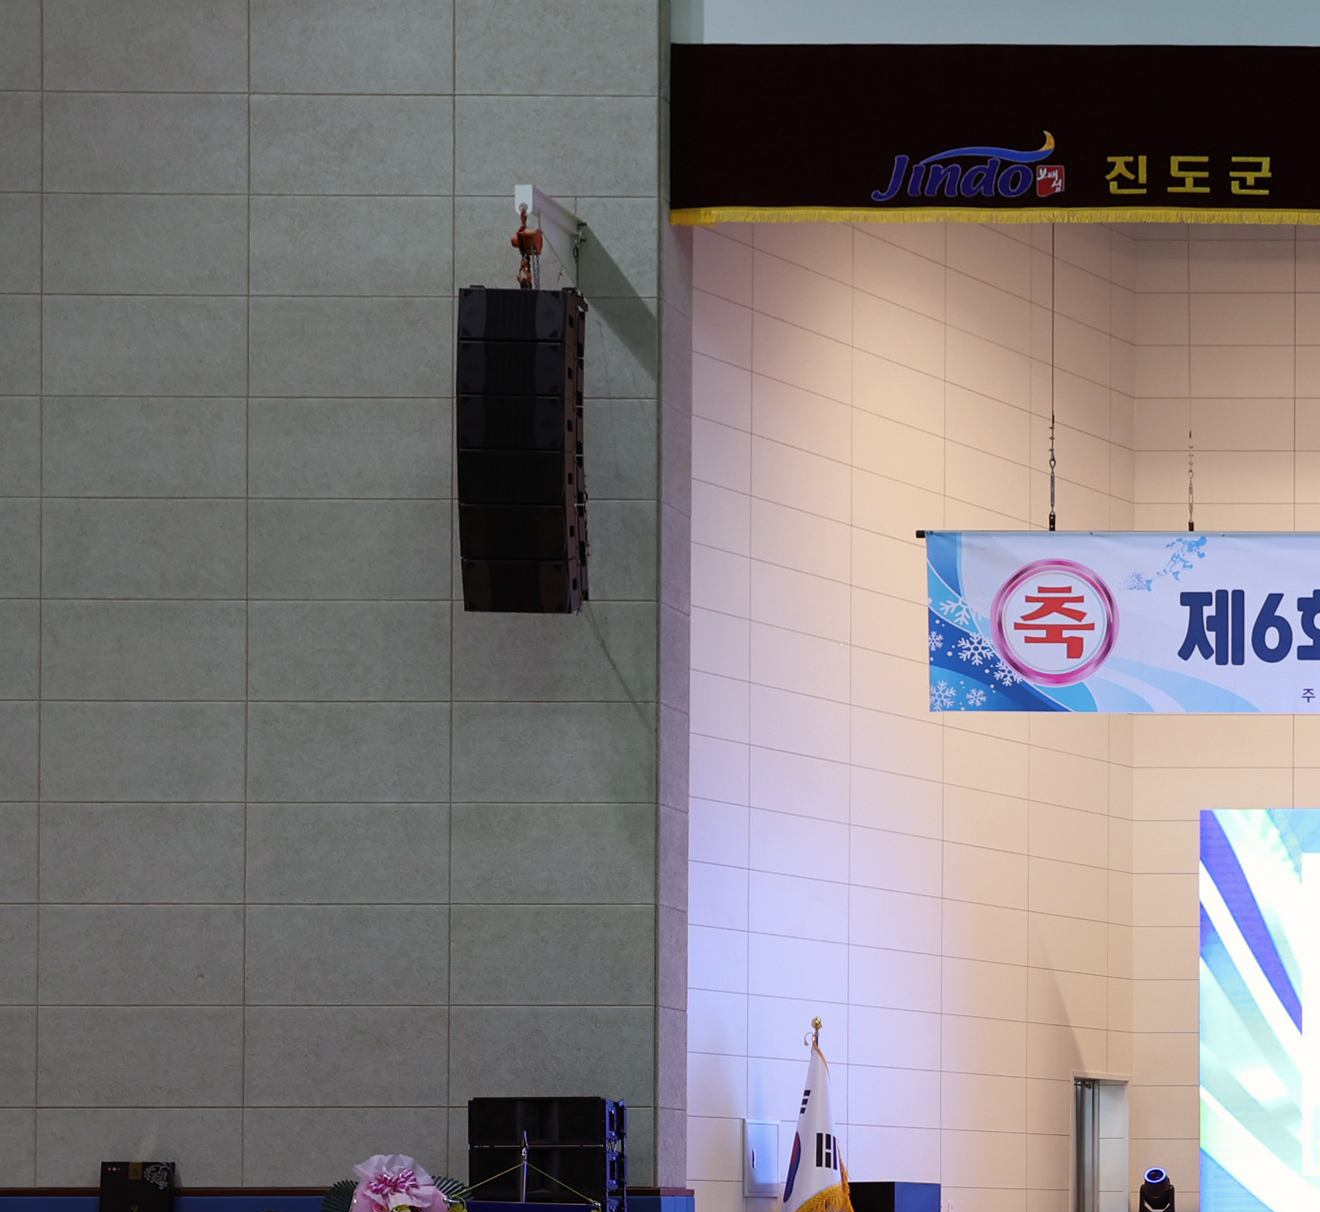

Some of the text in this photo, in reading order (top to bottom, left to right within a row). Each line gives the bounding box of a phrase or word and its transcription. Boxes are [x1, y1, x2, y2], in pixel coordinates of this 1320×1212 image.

[871, 154, 1034, 201] Jindo
[1104, 154, 1273, 196] 진도군
[1013, 585, 1096, 660] 축
